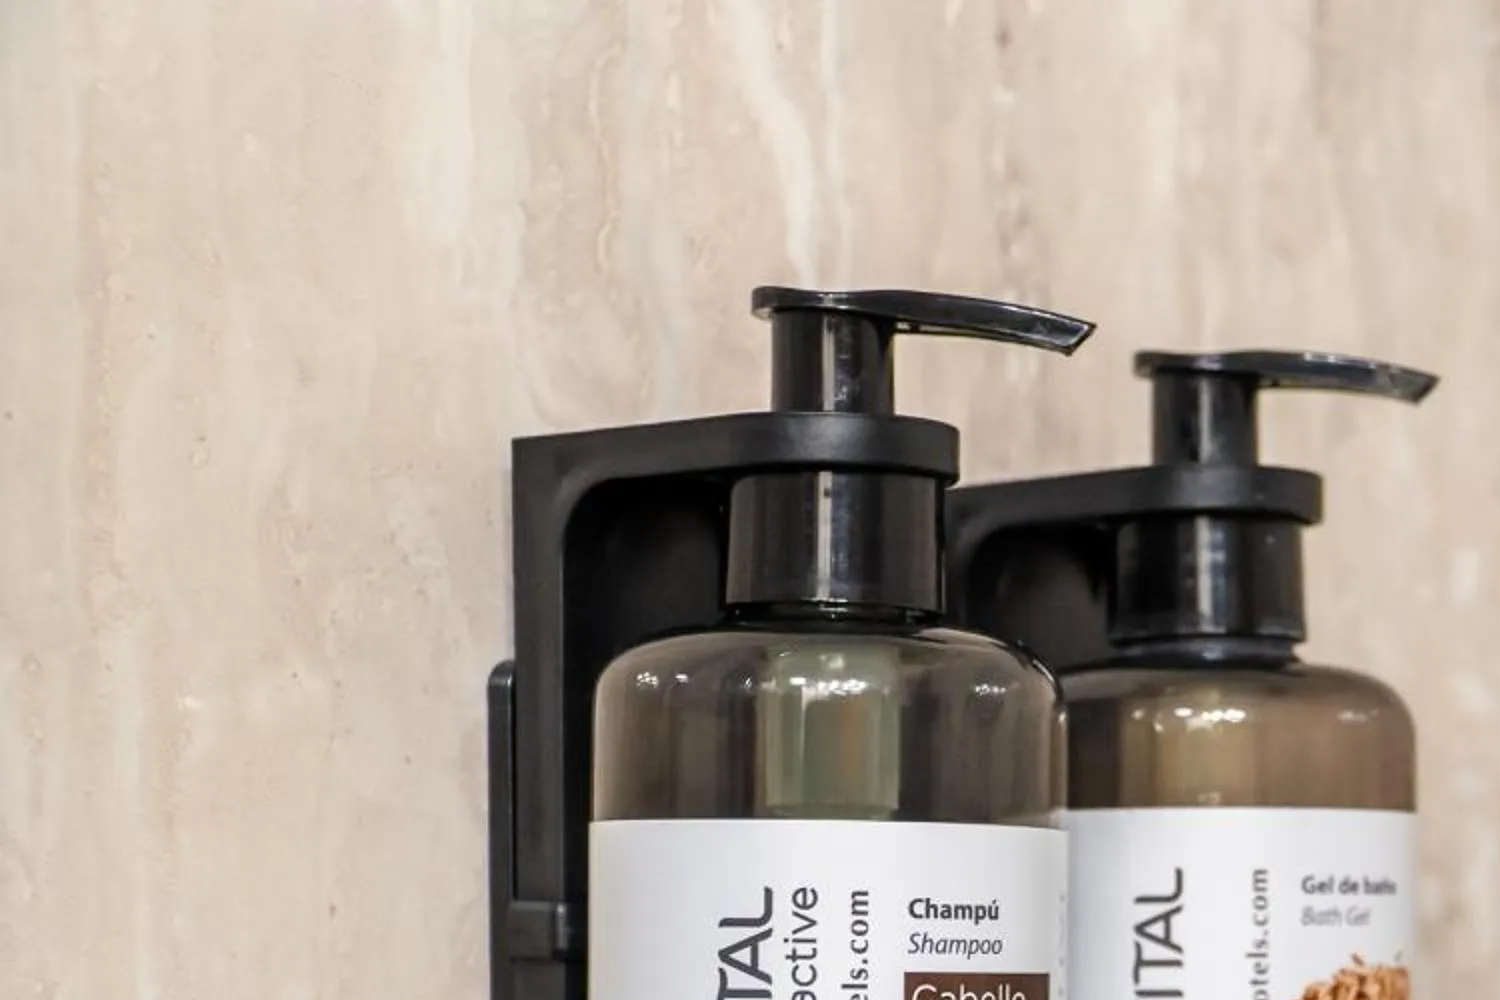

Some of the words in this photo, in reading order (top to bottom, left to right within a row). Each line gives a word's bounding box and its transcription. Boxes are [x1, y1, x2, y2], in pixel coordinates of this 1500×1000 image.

[1301, 873, 1335, 895] Gel
[908, 897, 1000, 925] Champú
[907, 932, 1003, 960] Shampoo
